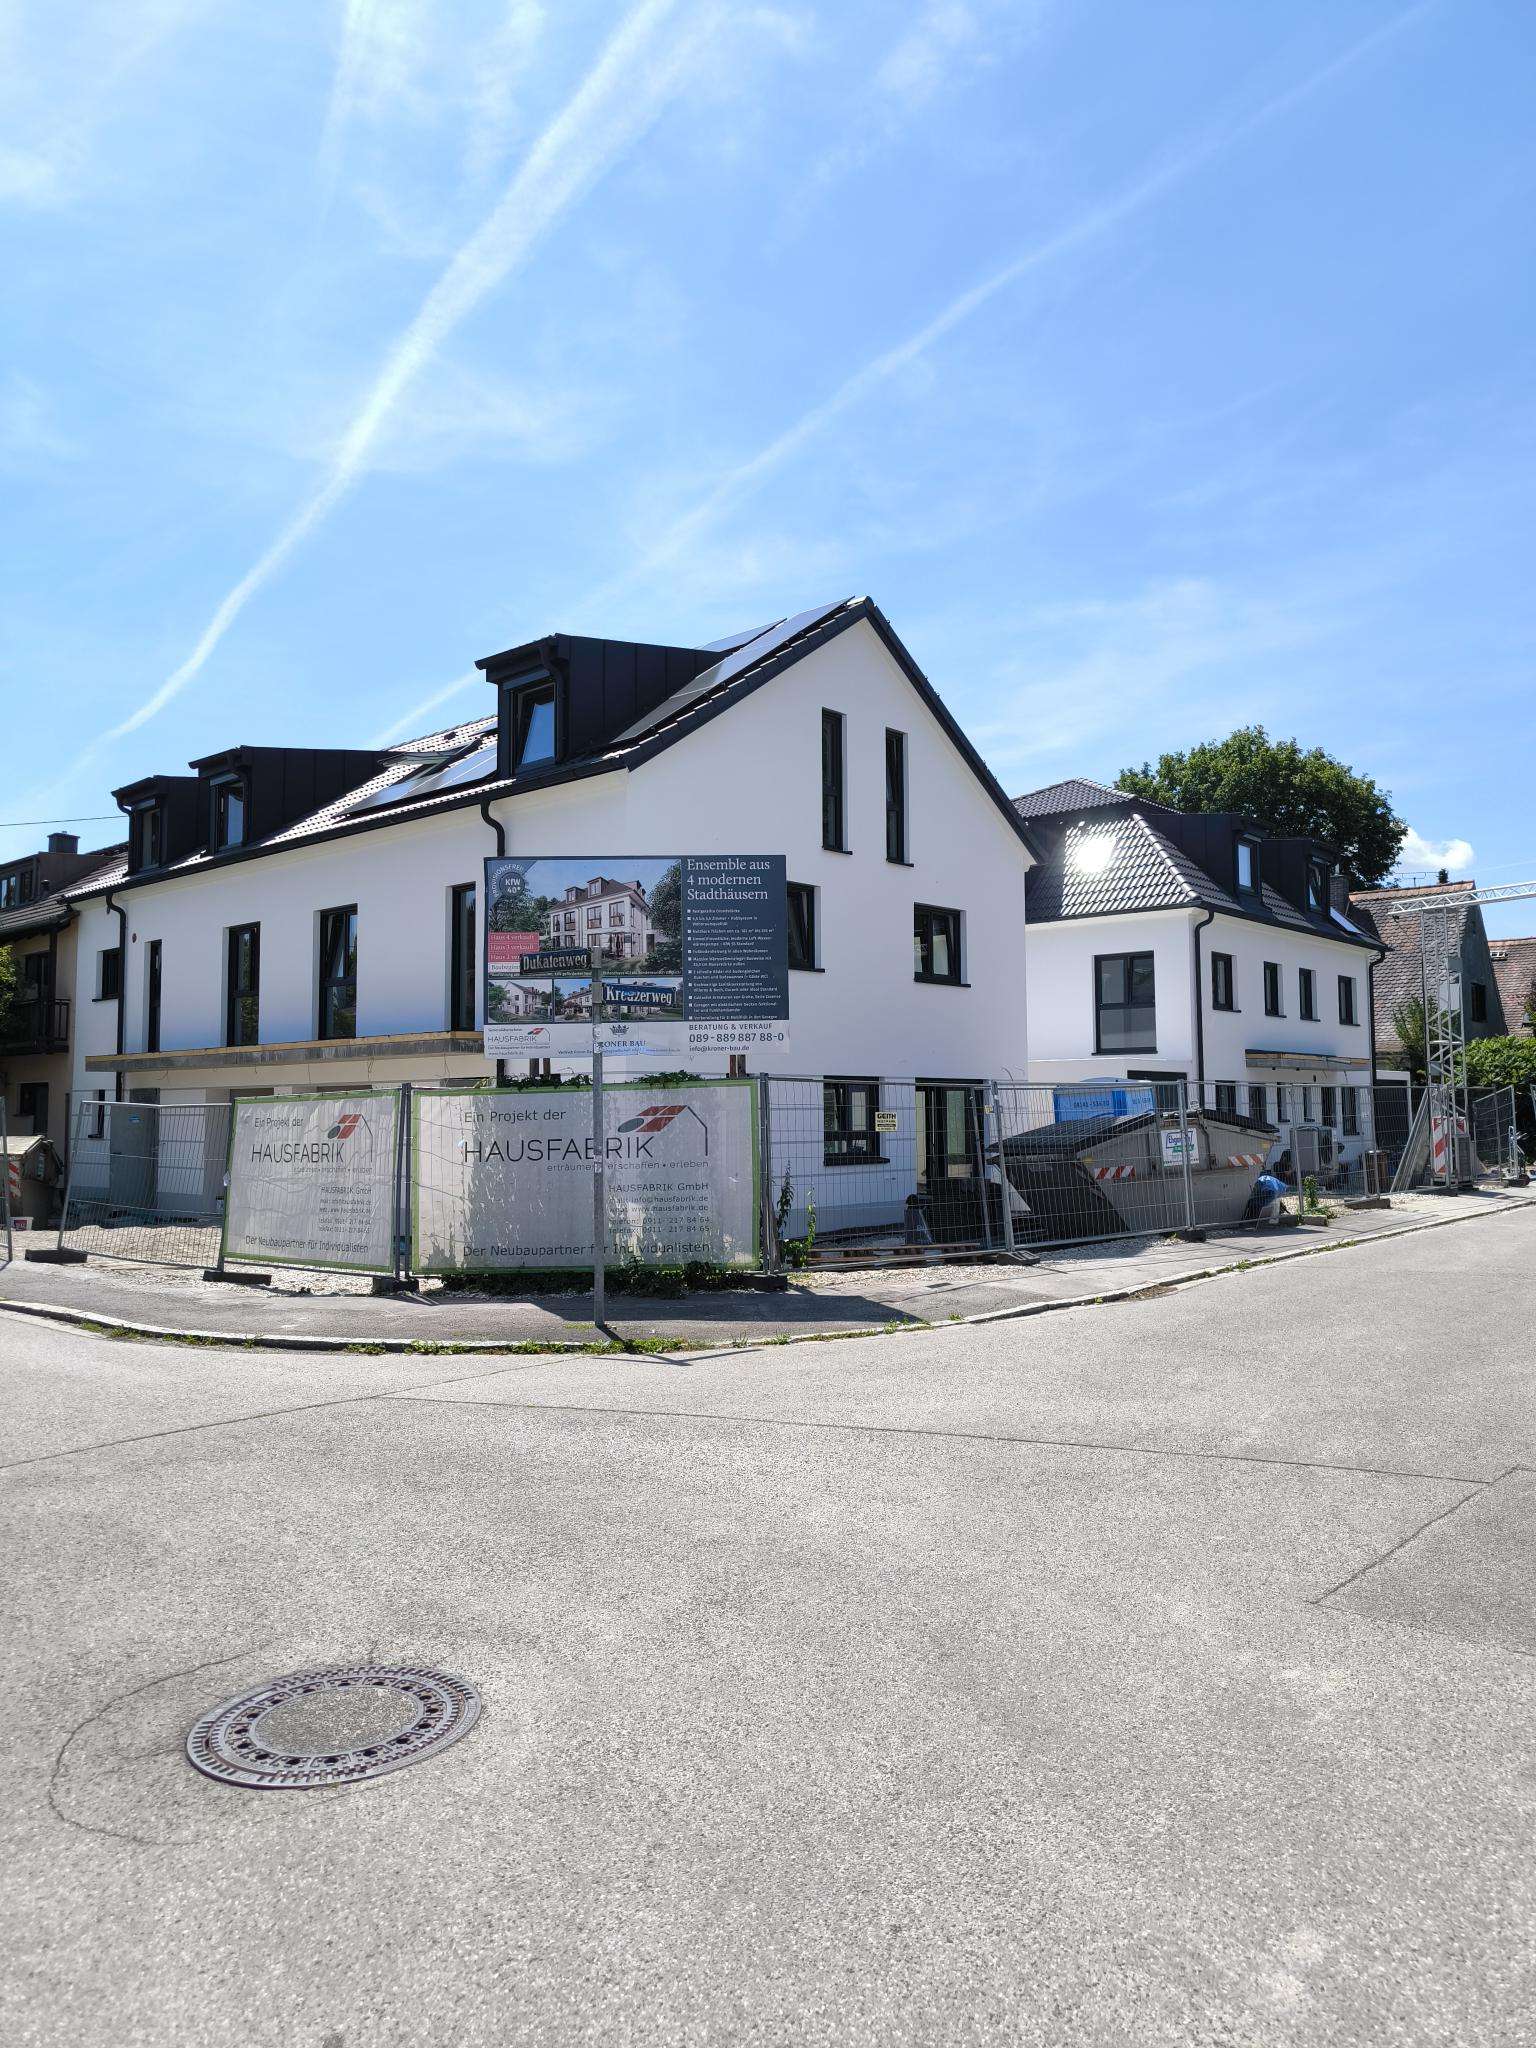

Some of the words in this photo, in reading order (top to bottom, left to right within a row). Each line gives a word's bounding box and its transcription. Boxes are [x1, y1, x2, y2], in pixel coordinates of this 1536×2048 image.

[687, 858, 746, 870] Ensemble
[749, 861, 770, 870] aus
[686, 875, 695, 885] 4
[698, 873, 762, 885] modernen
[687, 887, 769, 900] Stadthäusern
[523, 953, 588, 971] Dukatenweg
[488, 1035, 536, 1043] HAUSFABRIK
[738, 1033, 756, 1041] 887
[759, 1032, 784, 1041] 88-0
[464, 1111, 484, 1123] Ein
[490, 1109, 538, 1124] Projekt
[543, 1109, 566, 1121] der
[254, 1118, 266, 1128] Ein
[266, 1117, 290, 1130] Projekt
[292, 1117, 304, 1127] der
[251, 1142, 345, 1163] HAUSFABRIK
[464, 1135, 654, 1163] HAUSFABRIK
[607, 1160, 660, 1170] erschaffen
[669, 1160, 709, 1169] erleben
[609, 1183, 673, 1193] HAUSFABRIK
[677, 1182, 709, 1191] GmbH
[245, 1235, 257, 1245] Der
[258, 1236, 306, 1250] Neubaupartner
[319, 1240, 369, 1254] Individualisten
[463, 1245, 486, 1257] Der
[490, 1244, 586, 1258] Neubaupartner
[588, 1243, 609, 1255] fr
